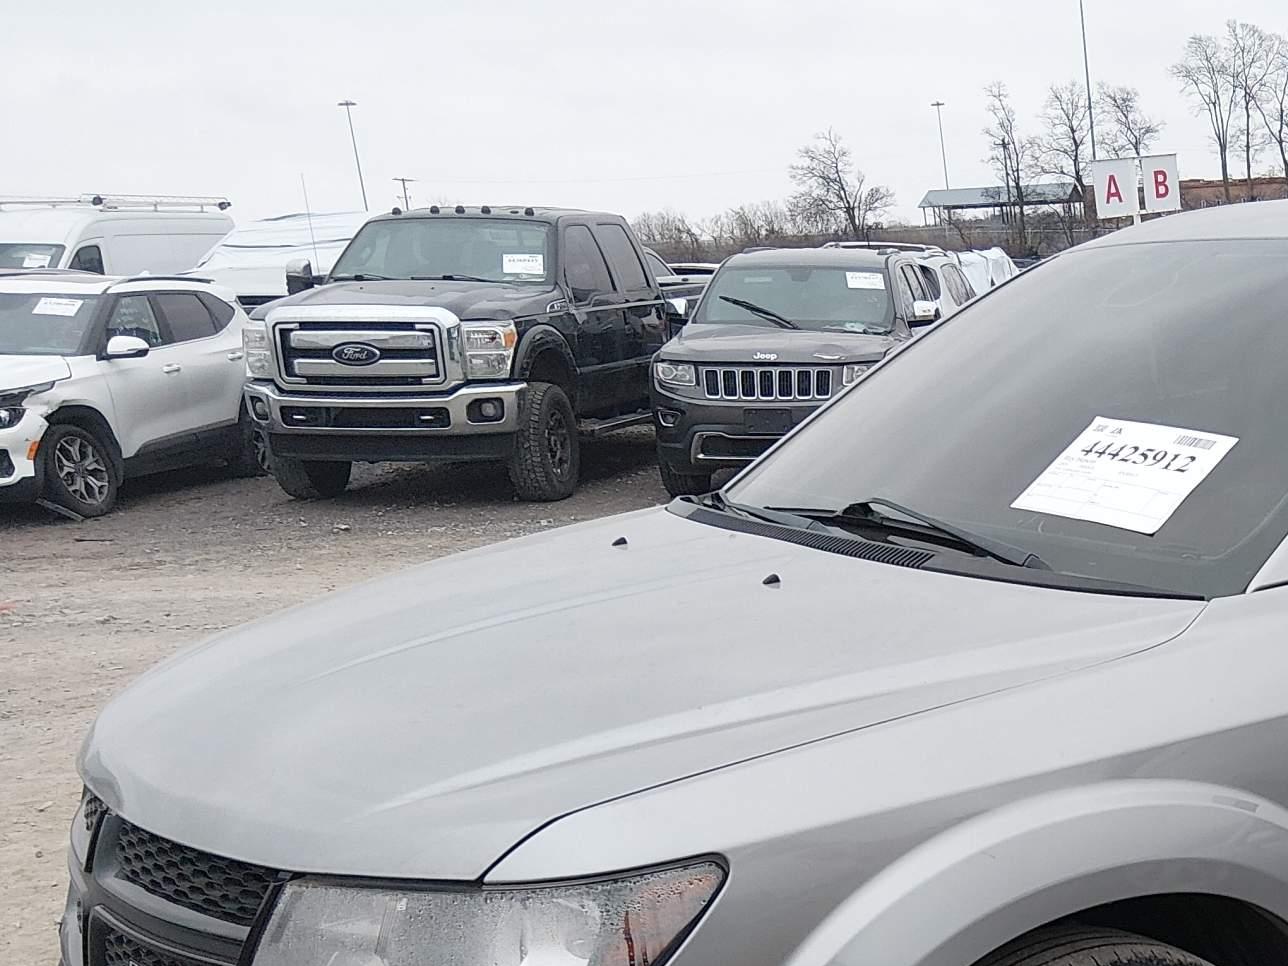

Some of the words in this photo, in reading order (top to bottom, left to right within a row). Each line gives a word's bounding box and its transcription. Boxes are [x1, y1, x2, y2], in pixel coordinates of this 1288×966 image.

[1105, 174, 1123, 205] A
[1152, 169, 1170, 199] B
[342, 347, 368, 360] Ford
[752, 351, 778, 361] Jeep
[1080, 440, 1197, 474] 44425912
